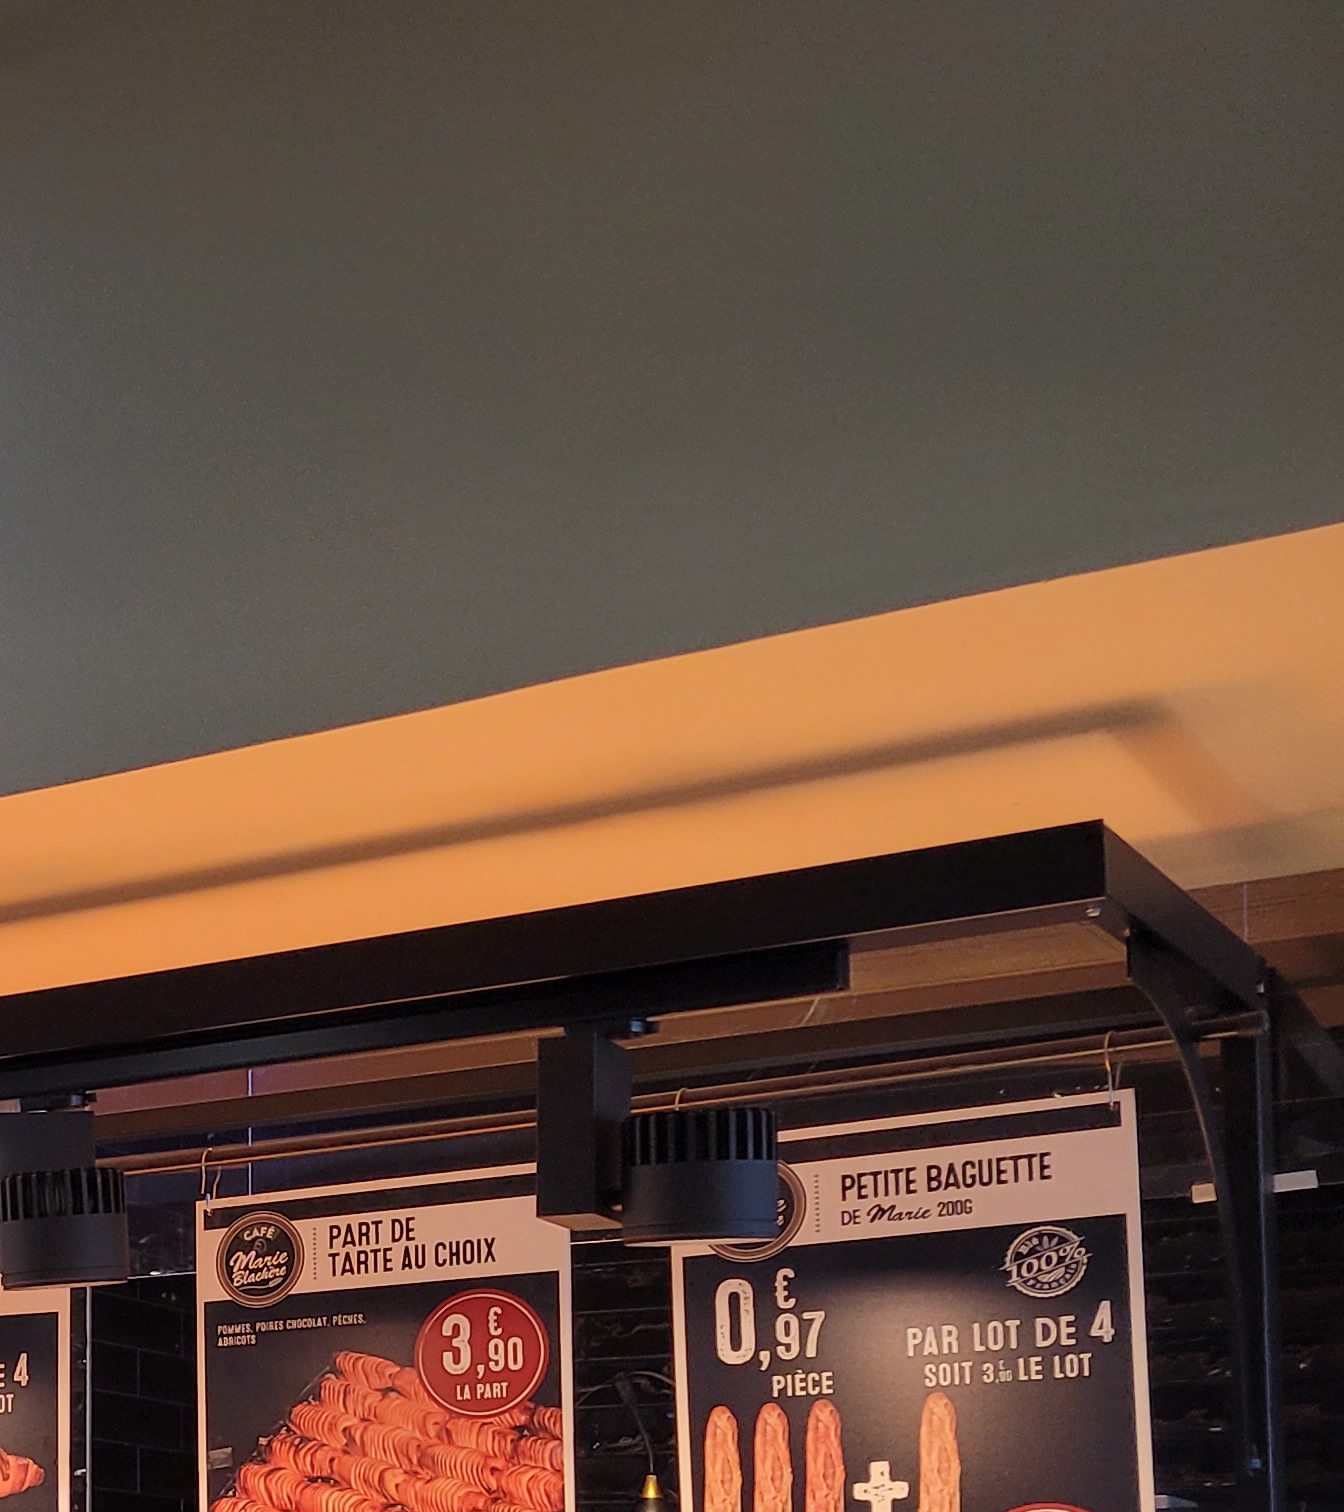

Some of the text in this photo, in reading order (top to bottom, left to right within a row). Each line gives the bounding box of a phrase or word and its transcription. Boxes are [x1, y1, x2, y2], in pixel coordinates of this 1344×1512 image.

[841, 1152, 1053, 1202] PETITE BAGUETTE
[841, 1199, 973, 1226] DE Marie 200G
[243, 1225, 276, 1241] CAFÉ
[328, 1216, 416, 1250] PART DE
[229, 1250, 289, 1274] Marie
[328, 1237, 497, 1278] TARTE AU CHOIX
[1007, 1240, 1086, 1283] 100%
[231, 1264, 288, 1288] Blachère
[217, 1334, 257, 1348] ABRICOTS
[906, 1300, 1115, 1357] PAR LOT DE 4
[13, 1352, 29, 1387] 4
[771, 1371, 834, 1398] PIÈCE
[924, 1353, 1092, 1389] SOIT LE LOT
[456, 1381, 509, 1400] LA PART
